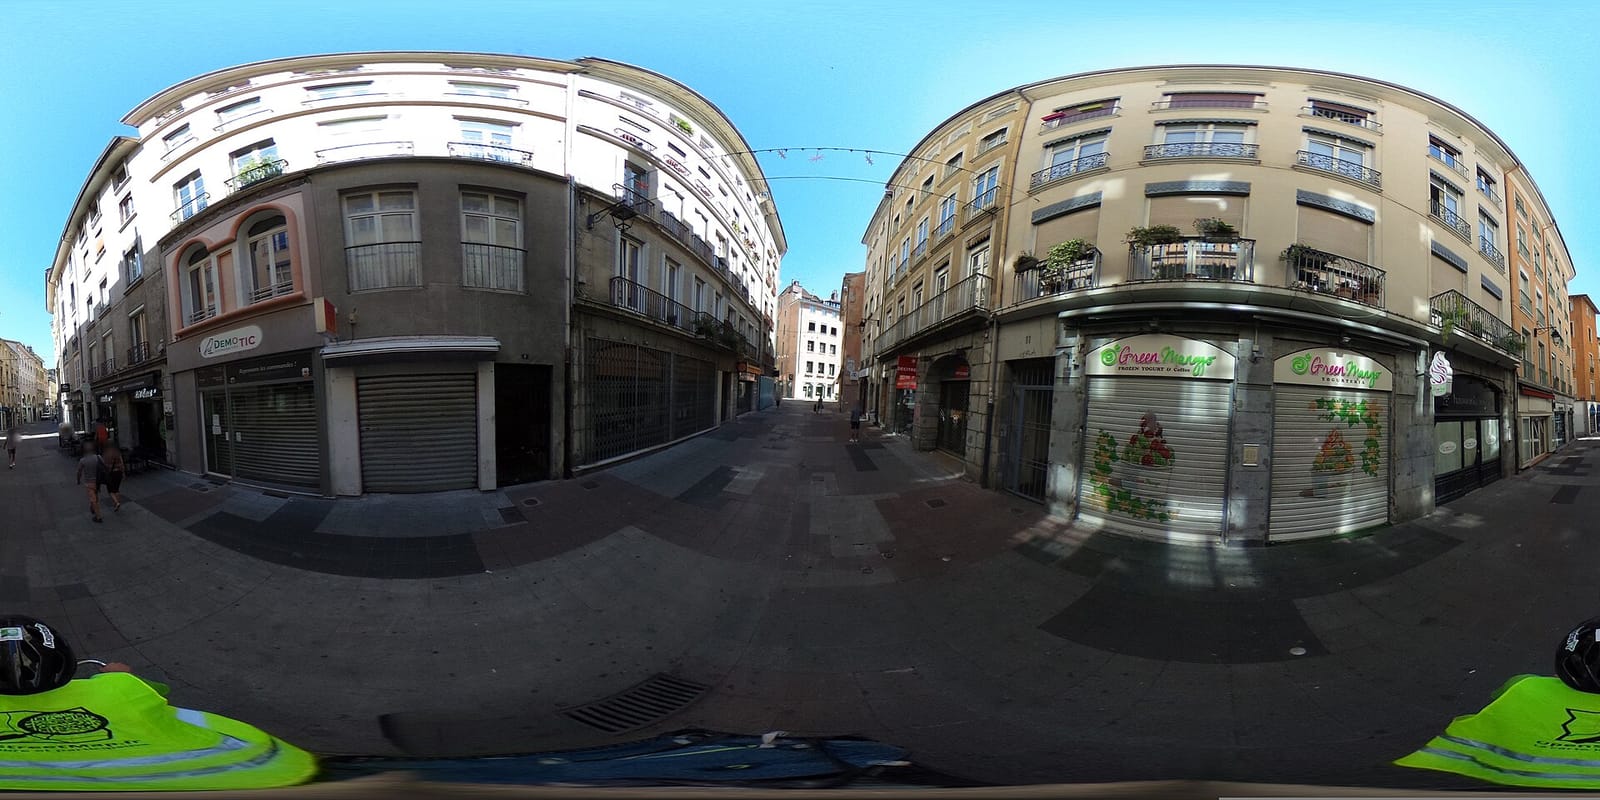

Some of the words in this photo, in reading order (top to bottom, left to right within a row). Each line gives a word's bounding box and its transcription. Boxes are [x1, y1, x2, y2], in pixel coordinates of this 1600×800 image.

[1119, 345, 1160, 365] Green
[1311, 357, 1345, 375] Green
[1346, 361, 1381, 387] Mango
